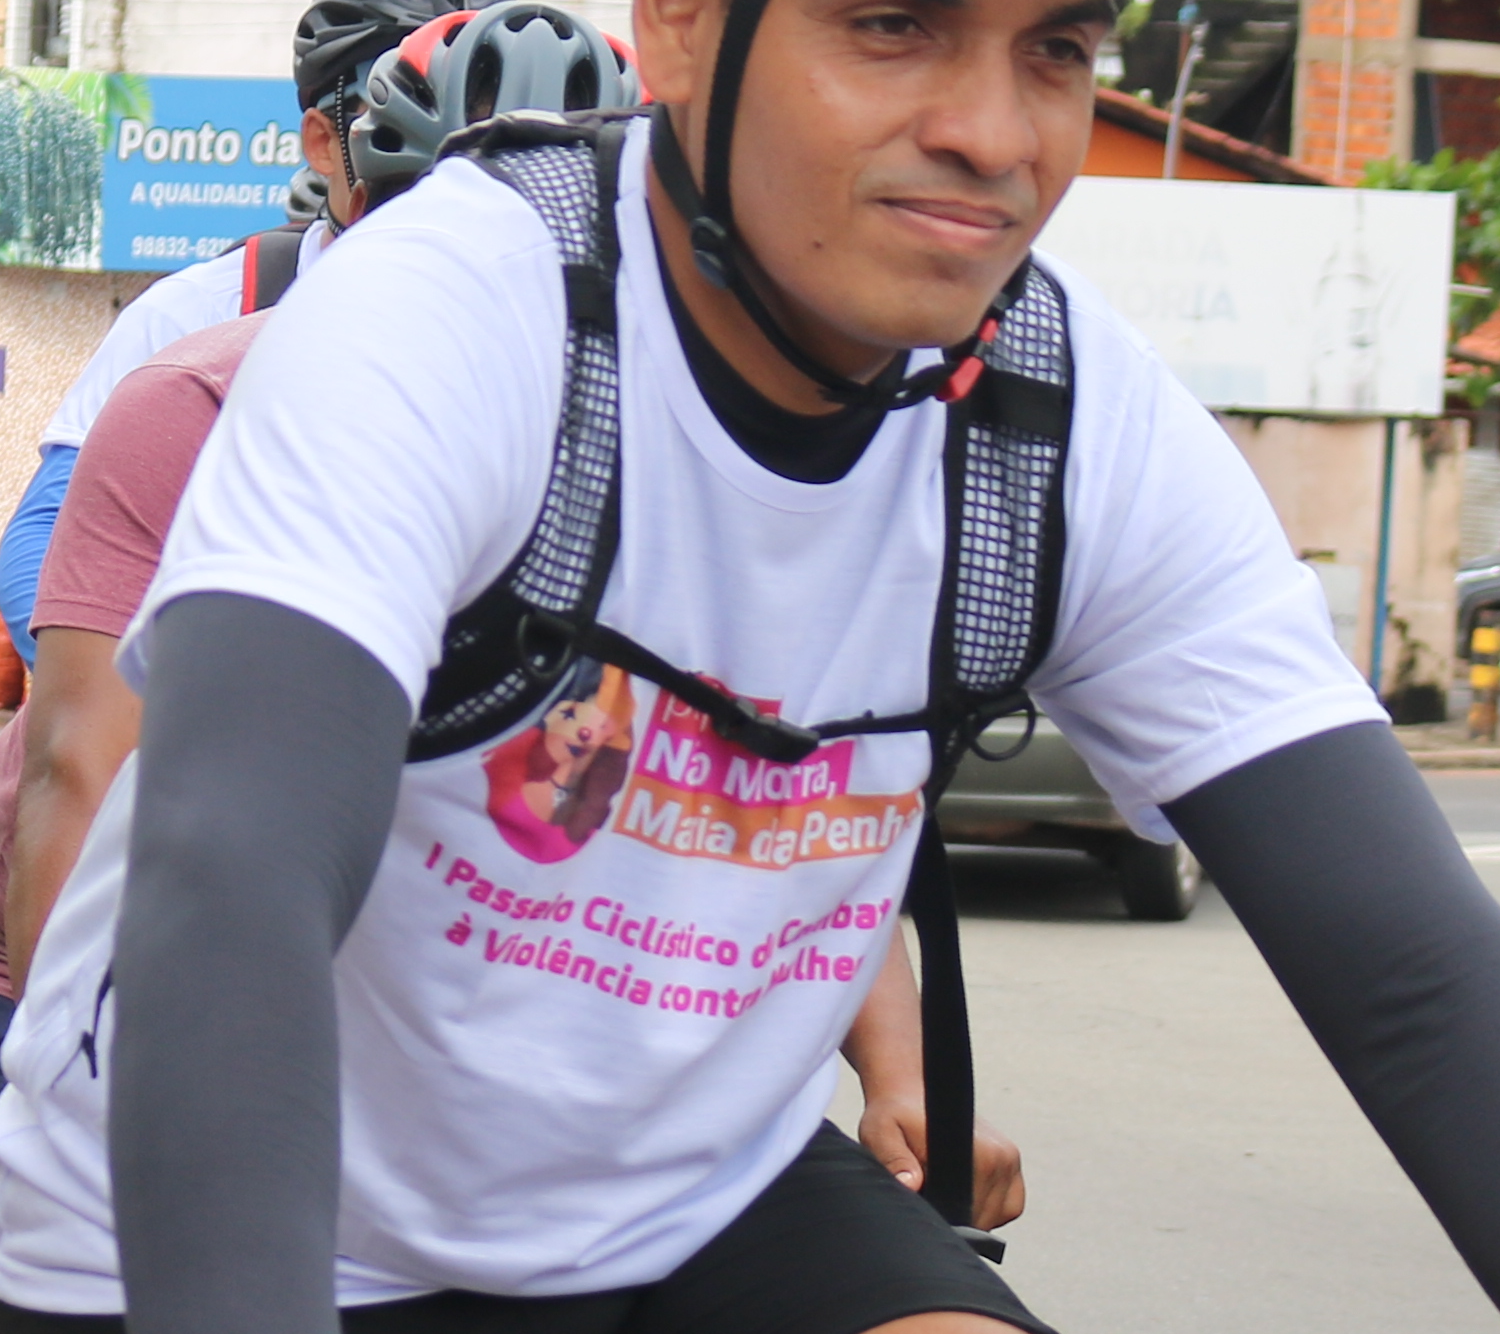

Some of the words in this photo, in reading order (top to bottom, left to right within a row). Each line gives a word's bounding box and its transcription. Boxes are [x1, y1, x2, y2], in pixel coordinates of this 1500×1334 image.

[118, 119, 241, 164] Ponto
[251, 122, 301, 165] da
[131, 182, 146, 202] A
[150, 182, 264, 209] QUALIDADE
[267, 185, 289, 204] FA
[751, 817, 798, 866] da
[444, 856, 575, 923] Passeio
[582, 896, 740, 968] Ciclístico
[445, 911, 473, 947] à
[484, 929, 651, 1009] Violência
